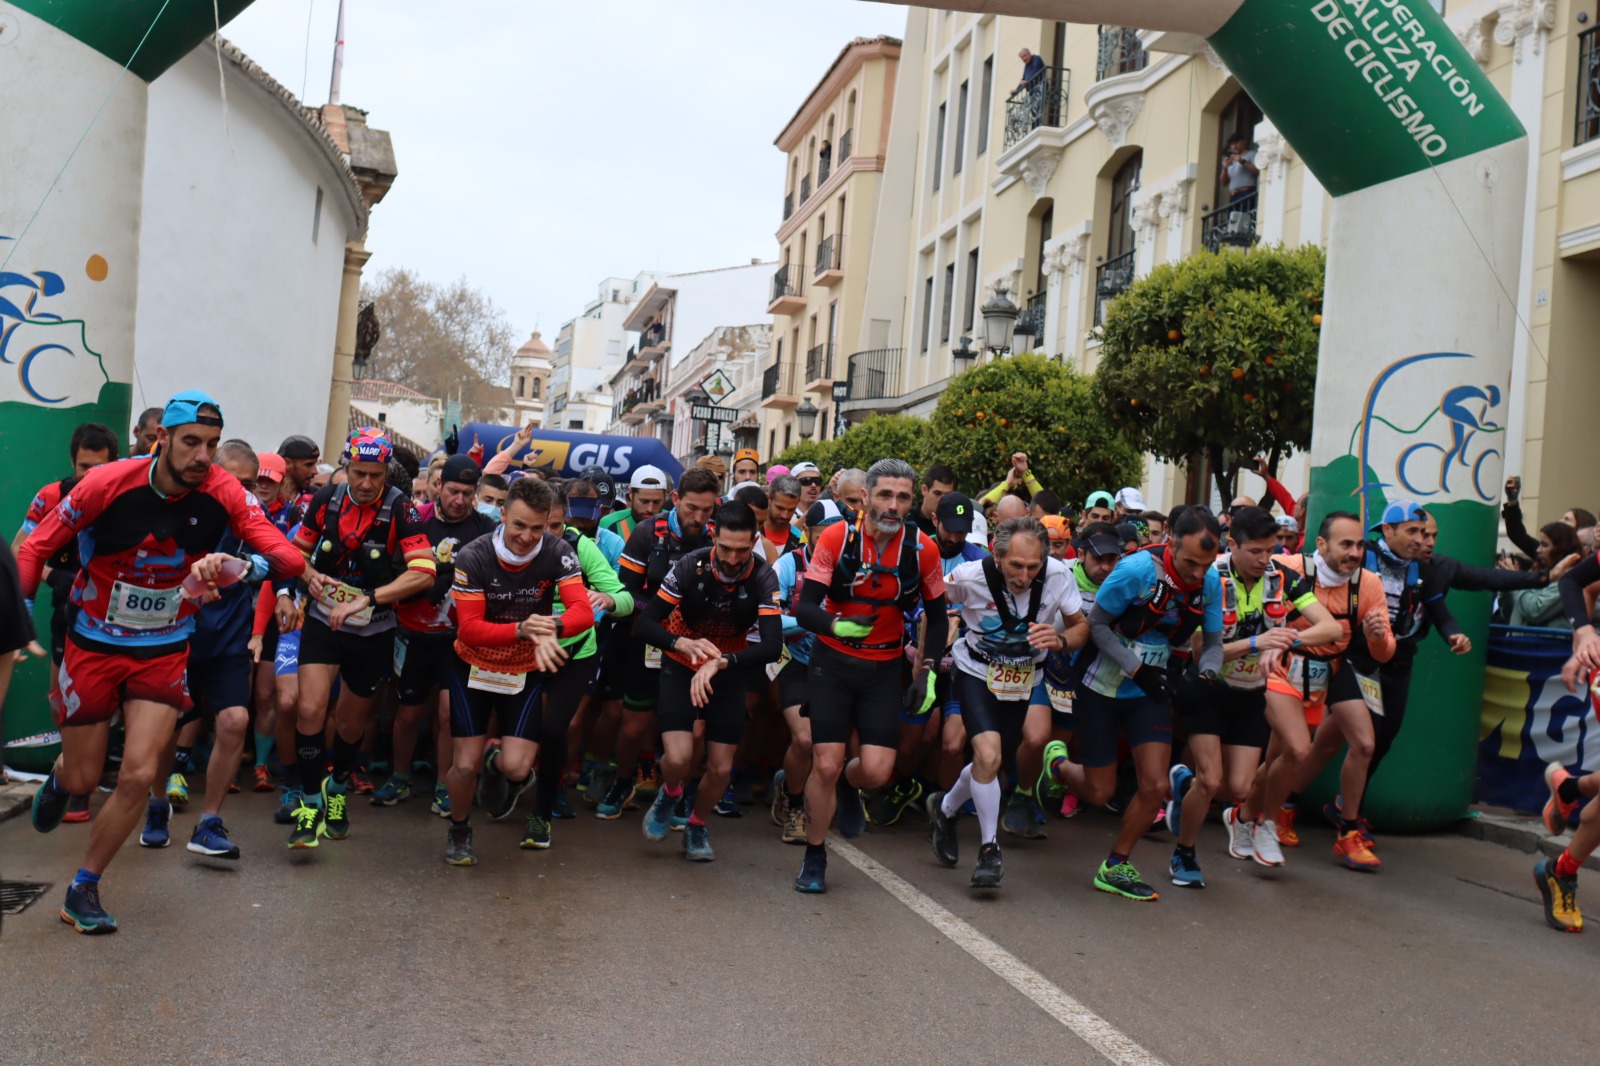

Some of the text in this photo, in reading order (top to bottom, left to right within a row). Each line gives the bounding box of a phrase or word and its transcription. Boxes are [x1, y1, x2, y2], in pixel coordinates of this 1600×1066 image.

[1344, 0, 1421, 82] ALUZA
[1311, 0, 1447, 157] DE CICLISMO
[360, 446, 380, 456] MAPEI
[569, 442, 632, 475] GLS
[125, 594, 167, 612] 806
[993, 668, 1031, 684] 2667
[1301, 667, 1326, 679] 37
